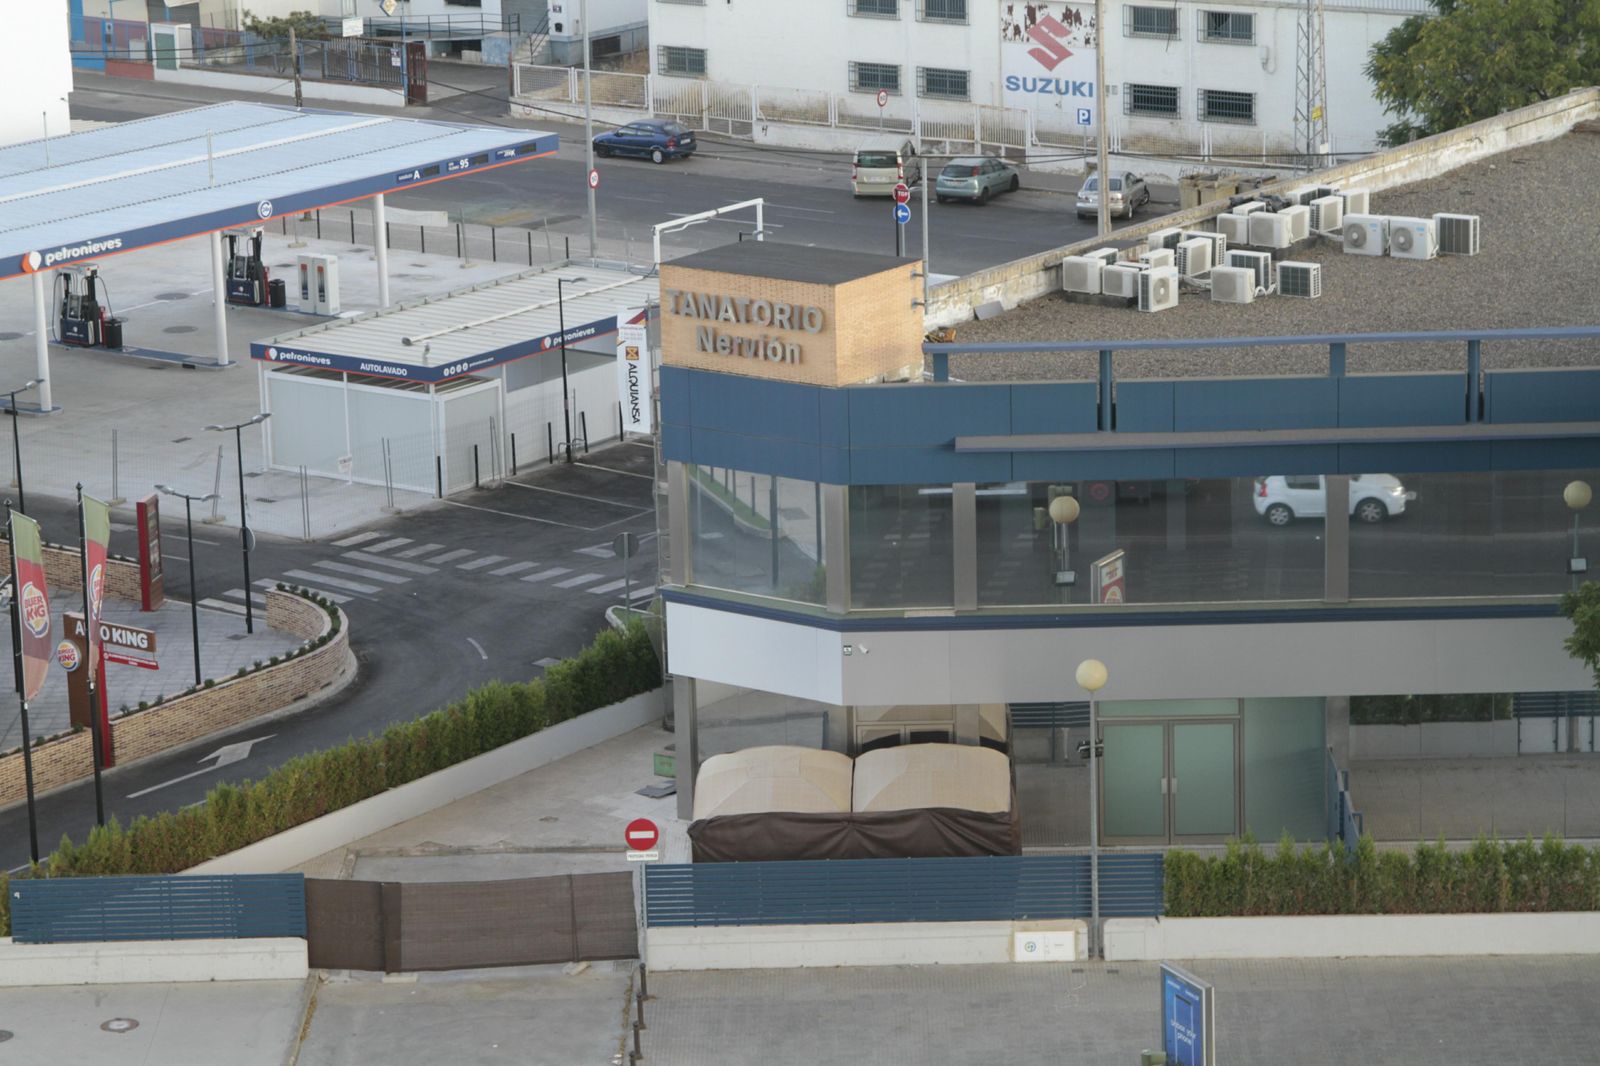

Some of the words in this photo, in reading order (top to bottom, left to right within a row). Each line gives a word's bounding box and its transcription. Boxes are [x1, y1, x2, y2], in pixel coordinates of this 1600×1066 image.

[1005, 75, 1094, 98] SUZUKI
[1079, 110, 1089, 124] P
[459, 158, 469, 169] 95
[413, 169, 421, 180] A
[45, 238, 123, 266] petronieves
[665, 288, 825, 334] TANATORIO
[553, 326, 596, 346] peronieves
[695, 325, 802, 366] Nervión
[279, 350, 331, 366] petronieves
[360, 362, 408, 377] AUTOLAVADO
[628, 362, 641, 424] ALQUIANSA
[75, 620, 110, 640] AO
[112, 627, 149, 649] KING
[58, 652, 76, 664] KING
